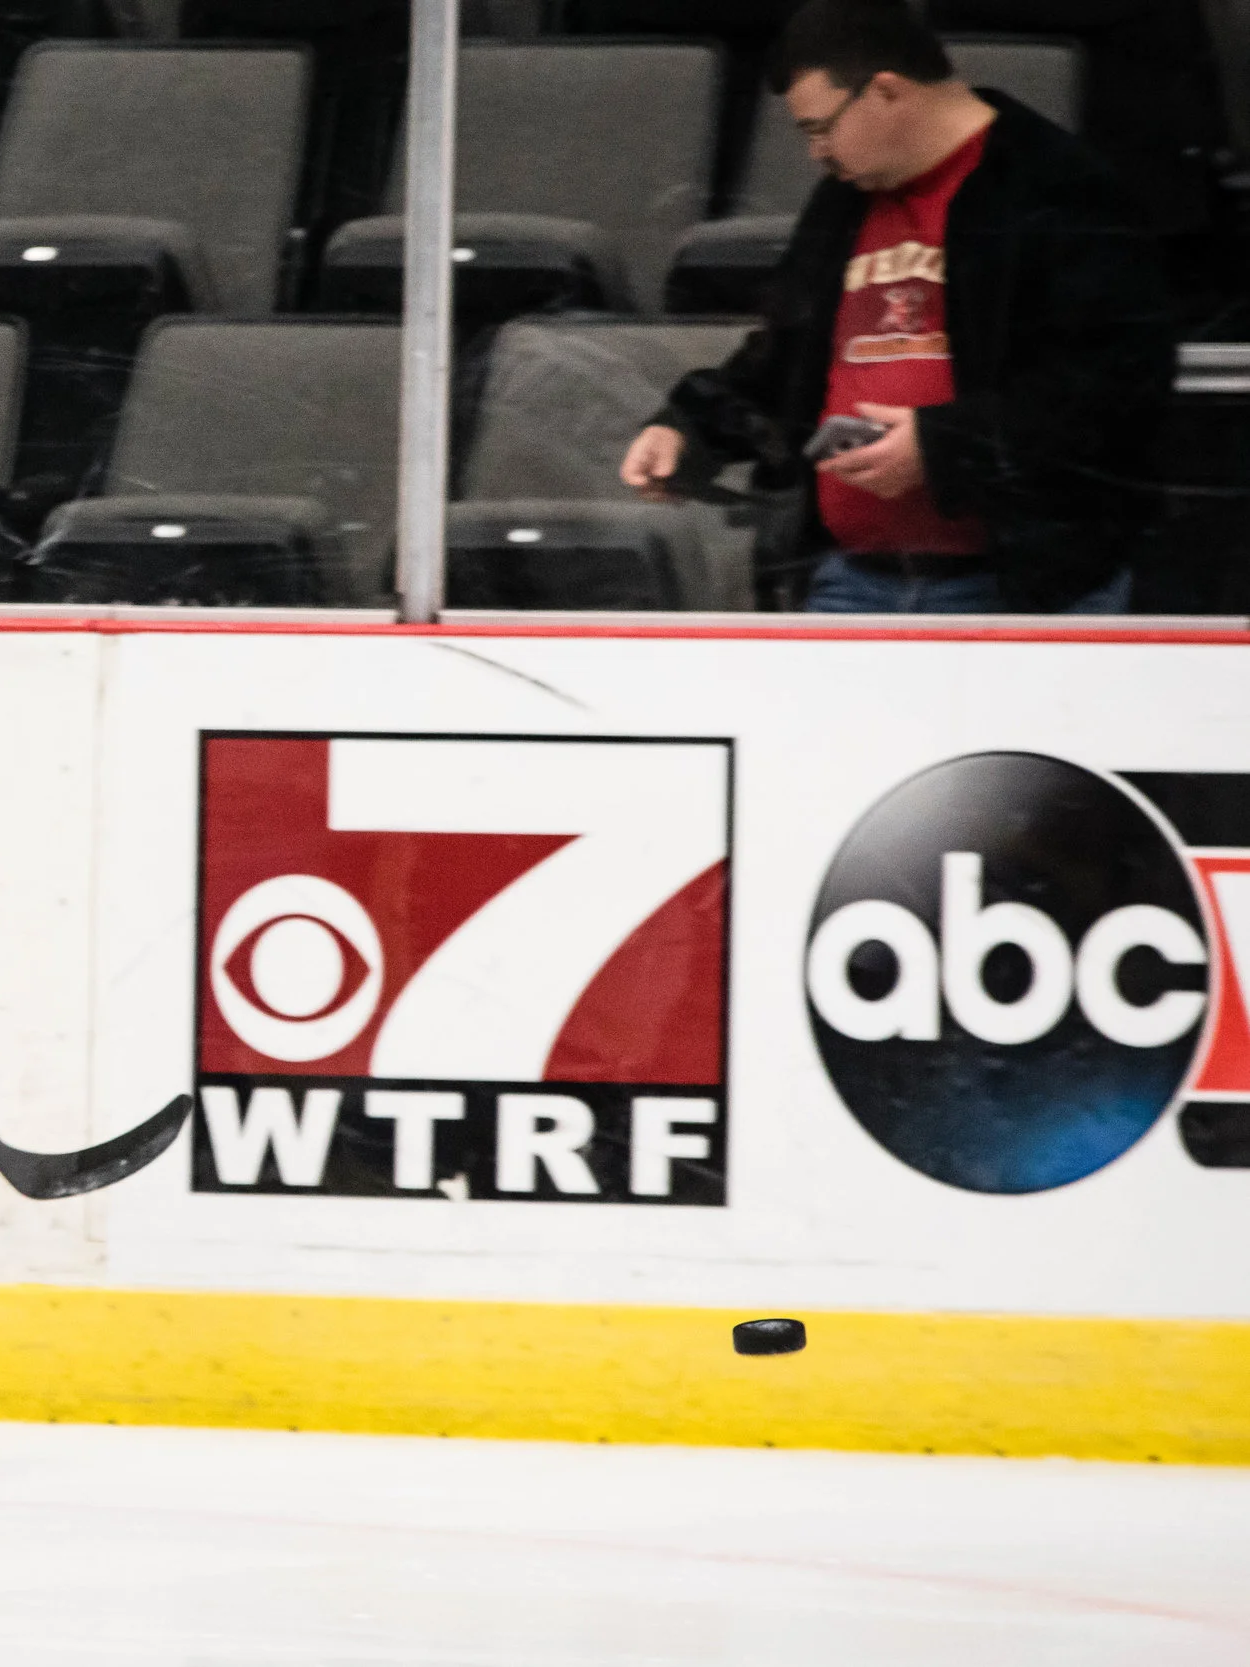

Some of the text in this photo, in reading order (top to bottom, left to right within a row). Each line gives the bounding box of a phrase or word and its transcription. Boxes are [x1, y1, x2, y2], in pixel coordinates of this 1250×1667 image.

[327, 738, 729, 1083] 7
[806, 851, 1209, 1049] abc
[199, 1084, 719, 1197] WTRF
